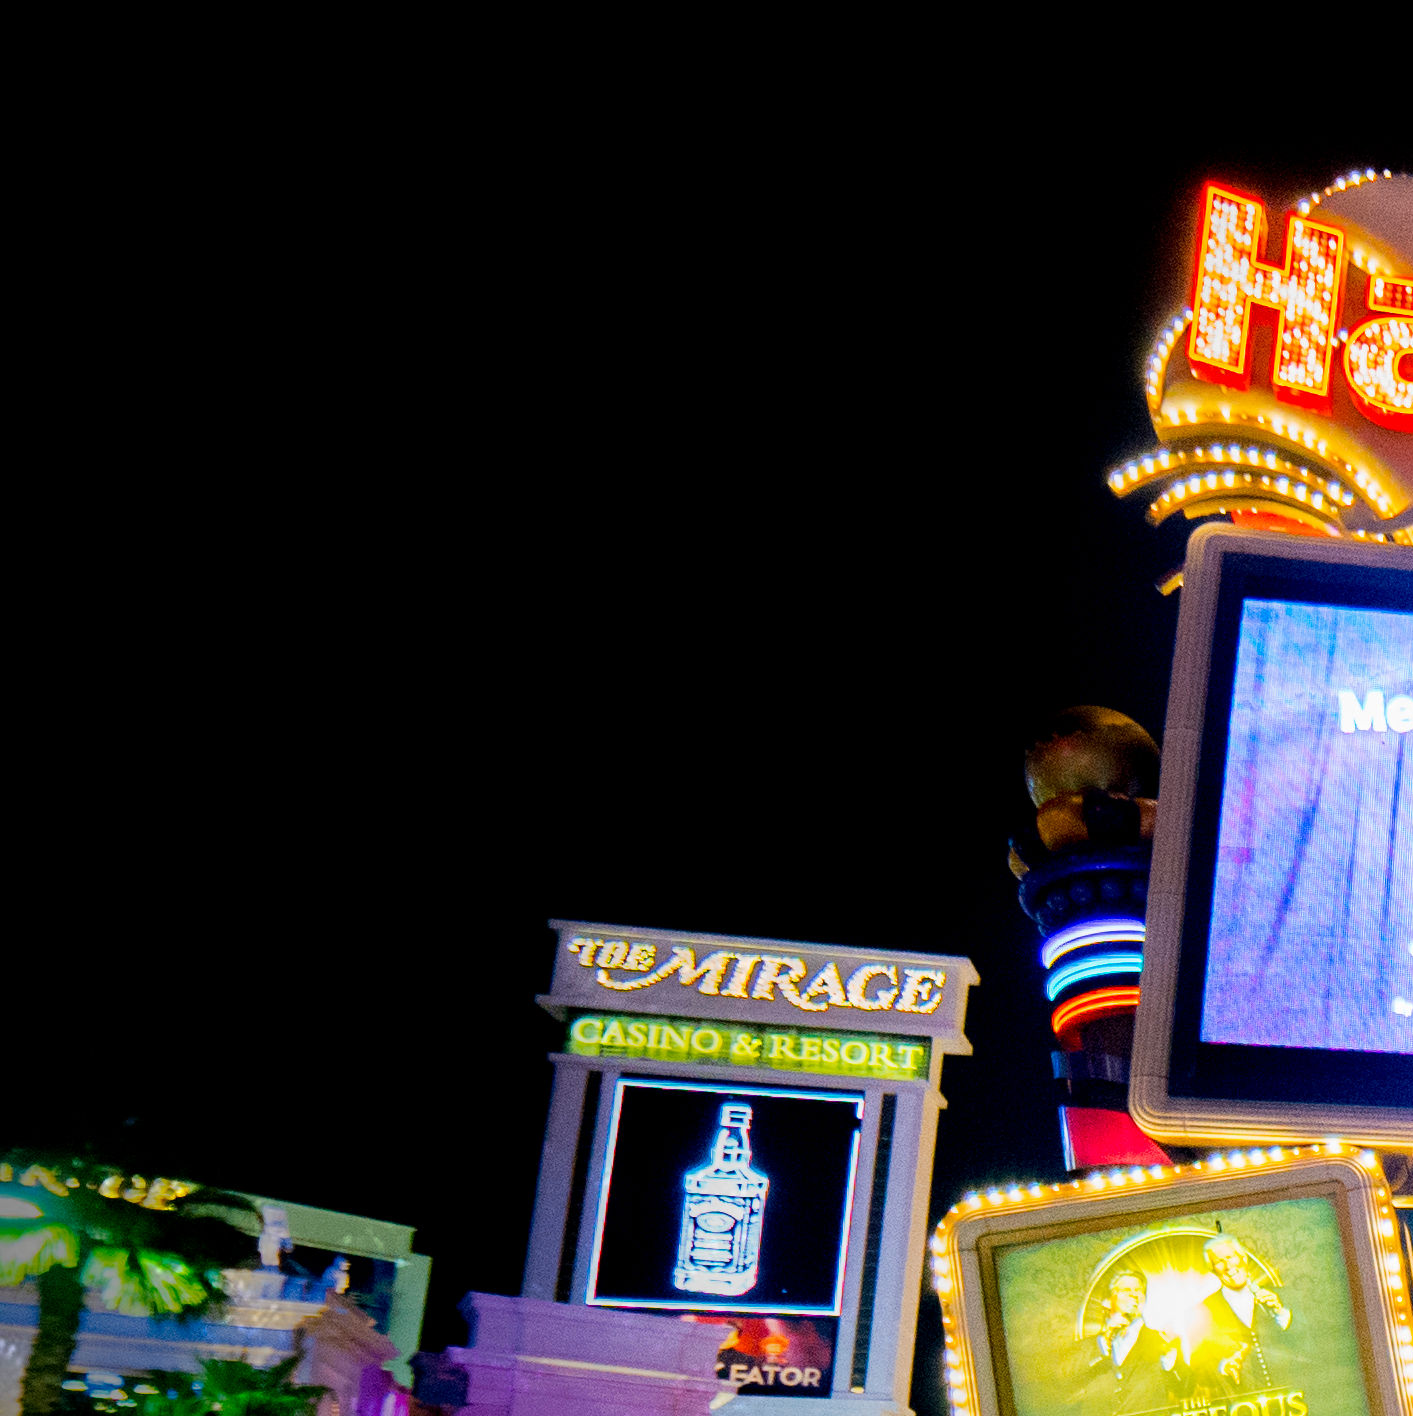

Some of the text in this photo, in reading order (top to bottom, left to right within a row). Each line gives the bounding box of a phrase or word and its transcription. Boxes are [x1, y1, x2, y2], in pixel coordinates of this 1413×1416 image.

[596, 947, 946, 1015] MIRAGE
[570, 1016, 925, 1071] CASINO & RESORT
[1181, 1396, 1212, 1411] THE
